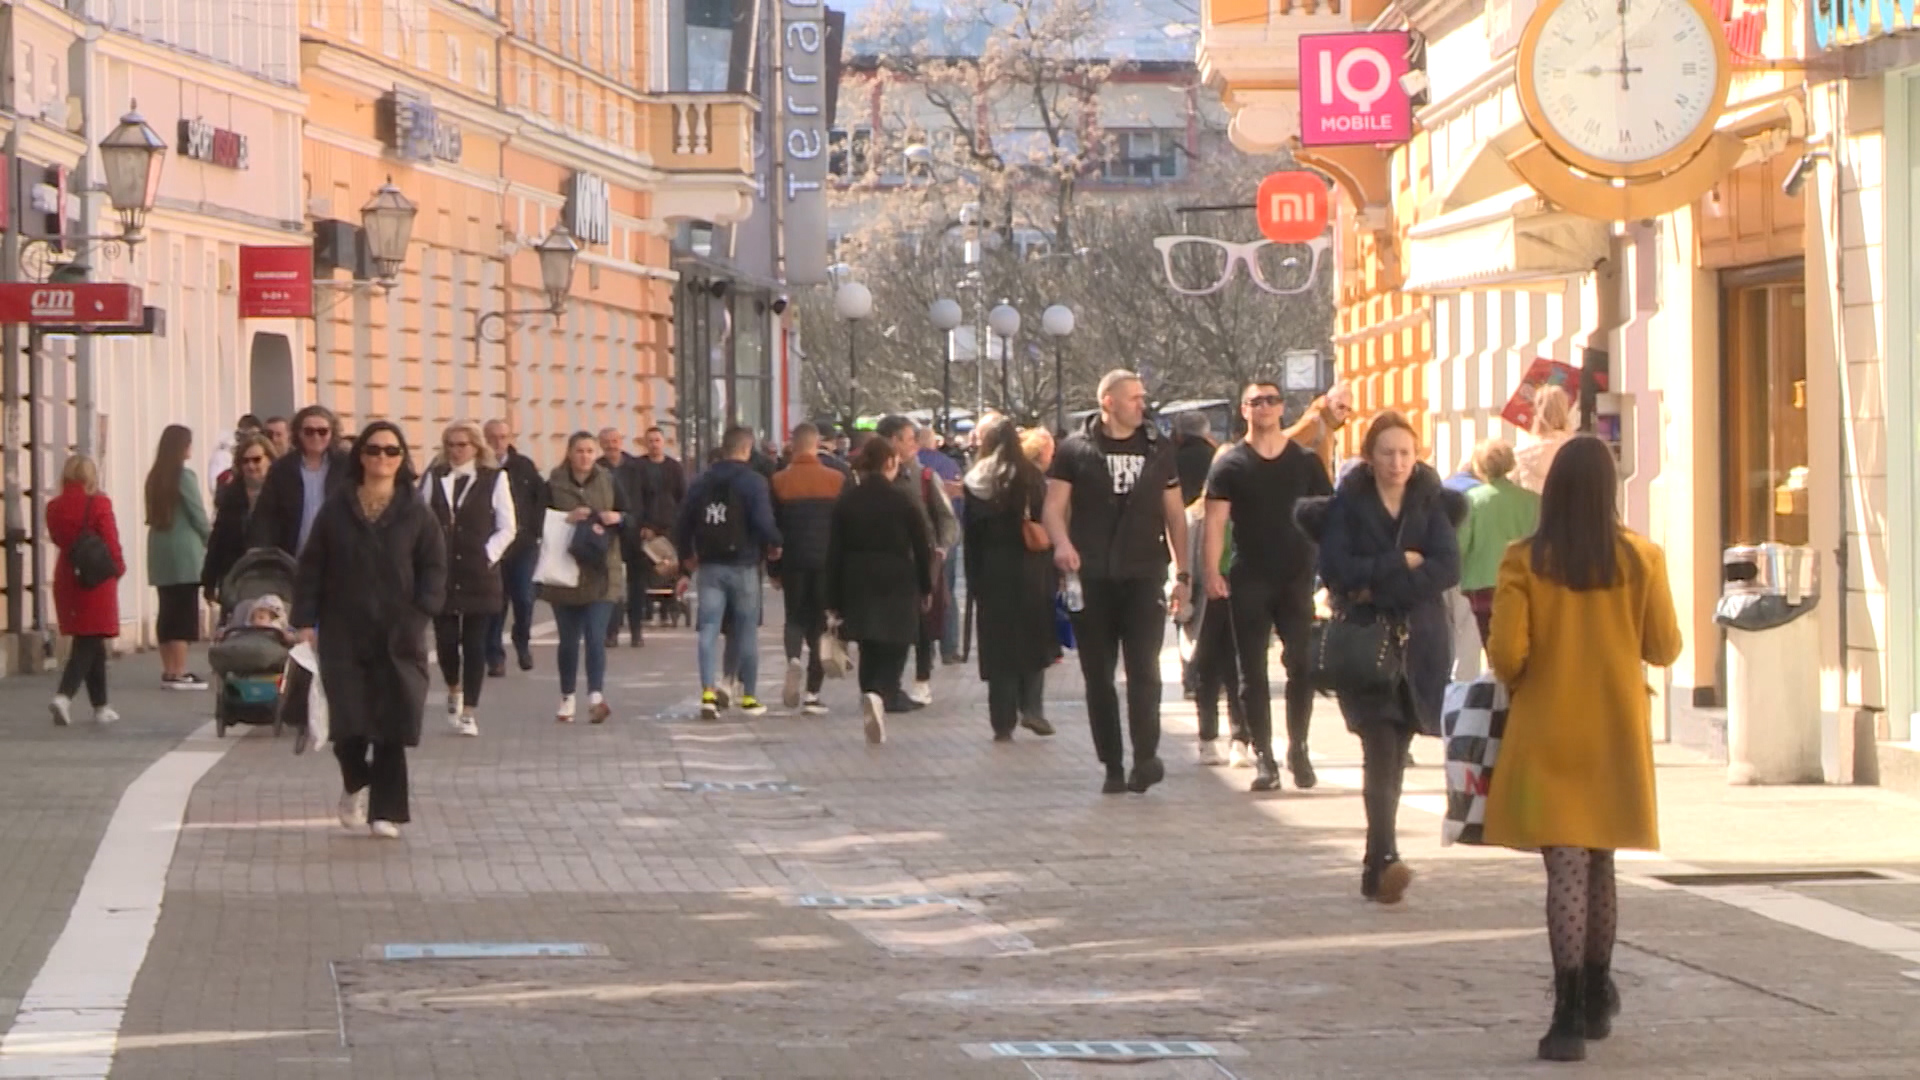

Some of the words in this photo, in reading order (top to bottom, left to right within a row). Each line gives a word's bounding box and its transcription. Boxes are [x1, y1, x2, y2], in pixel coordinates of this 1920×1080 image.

[1319, 47, 1391, 113] IQ
[1320, 114, 1391, 132] MOBILE
[31, 289, 75, 308] cm
